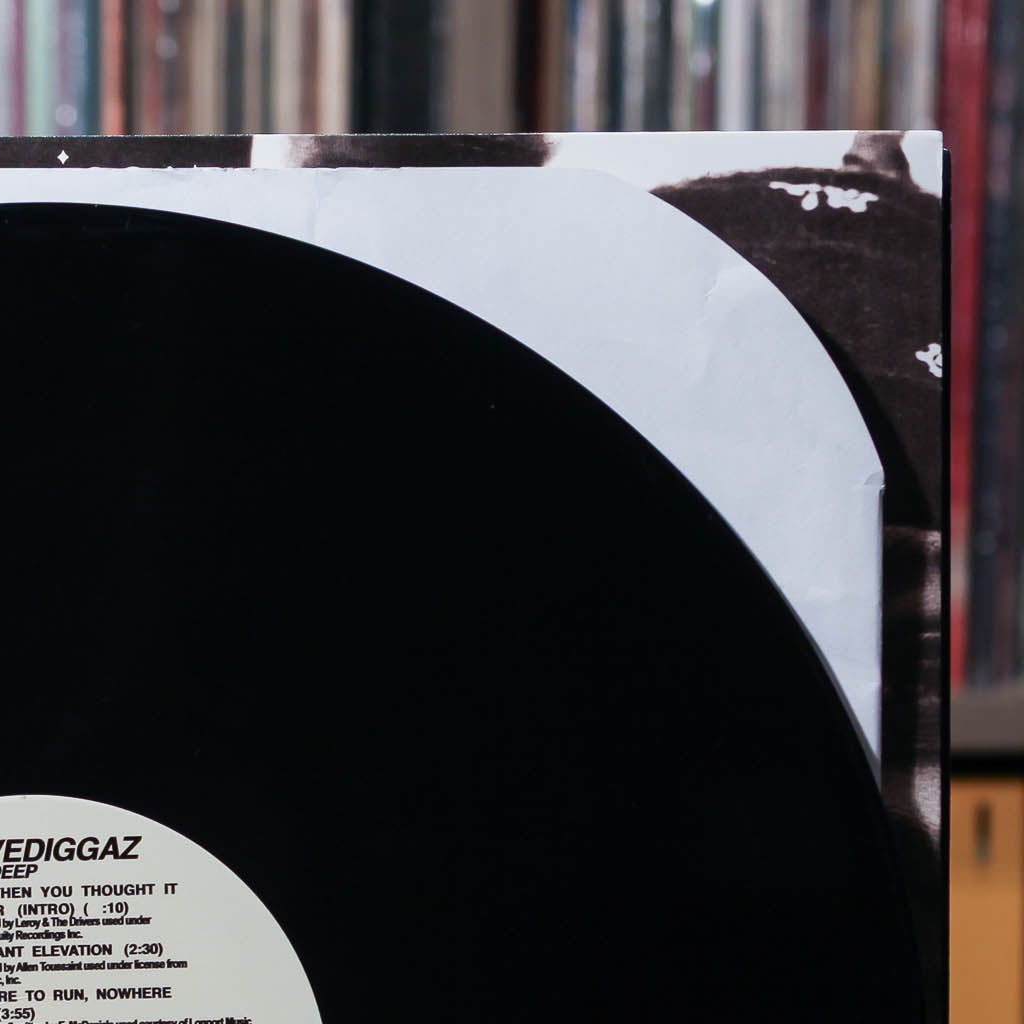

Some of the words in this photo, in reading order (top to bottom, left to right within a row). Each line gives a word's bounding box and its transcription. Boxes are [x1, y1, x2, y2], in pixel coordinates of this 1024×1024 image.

[40, 886, 73, 898] YOU
[81, 884, 156, 897] THOUGHT
[164, 883, 177, 895] IT
[18, 903, 75, 919] (INTRO)
[2, 918, 14, 930] by
[15, 918, 41, 929] Leroy
[42, 918, 49, 927] &
[51, 917, 68, 927] The
[69, 917, 100, 927] Drivers
[102, 916, 124, 925] used
[125, 915, 152, 925] under
[16, 930, 66, 942] Recordings
[67, 930, 83, 939] Inc.
[32, 944, 112, 958] ELEVATION
[124, 943, 164, 957] (2:30)
[4, 962, 15, 974] by
[16, 962, 39, 972] Allen
[84, 960, 105, 970] used
[107, 960, 133, 969] under
[134, 959, 165, 969] license
[166, 959, 188, 968] from
[5, 975, 21, 985] Inc.
[25, 990, 46, 1002] TO
[53, 989, 88, 1002] RUN,
[96, 987, 172, 1000] NOWHERE
